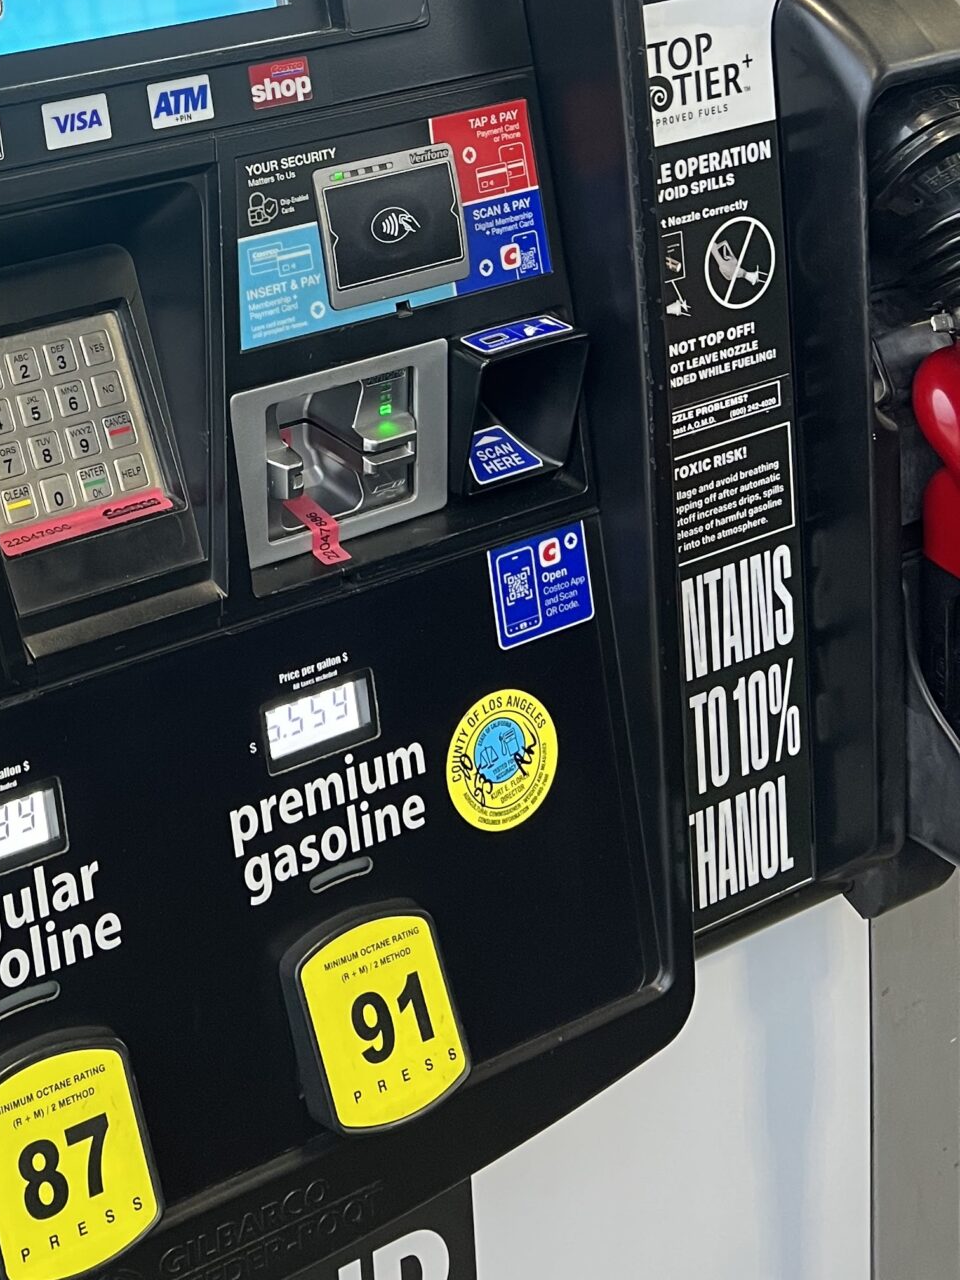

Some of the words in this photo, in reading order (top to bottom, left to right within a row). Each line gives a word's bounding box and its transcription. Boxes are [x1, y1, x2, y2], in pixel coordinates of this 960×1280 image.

[647, 33, 712, 73] TOP
[153, 84, 208, 119] ATM
[251, 73, 312, 104] shop
[51, 109, 102, 133] VISA
[469, 115, 489, 129] TAP
[499, 110, 518, 122] PAY
[699, 104, 728, 118] FUELS
[245, 156, 279, 176] YOUR
[280, 147, 336, 169] SECURITY
[409, 147, 449, 165] Verifone
[677, 139, 771, 181] OPERATION
[691, 173, 735, 195] SPILLS
[668, 212, 701, 228] Nozzle
[702, 198, 748, 219] Correctly
[669, 337, 697, 357] NOT
[698, 330, 724, 349] TOP
[726, 322, 755, 341] OFF!
[686, 351, 719, 370] LEAVE
[720, 340, 758, 360] NOZZLE
[476, 443, 514, 462] SCAN
[484, 455, 525, 475] HERE
[80, 466, 104, 480] ENTER
[4, 487, 29, 501] CLEAR
[542, 567, 567, 584] Open
[543, 580, 569, 595] Costco
[571, 574, 585, 589] App
[544, 594, 558, 607] and
[560, 588, 578, 602] Scan
[546, 605, 557, 617] QR
[558, 598, 579, 613] Code.
[681, 545, 794, 681] NTAINS
[689, 686, 730, 795] TO
[733, 658, 801, 777] 10%
[229, 742, 426, 858] premium
[244, 794, 426, 906] gasoline
[689, 775, 794, 909] HANOL
[351, 971, 435, 1064] 91
[36, 1078, 72, 1099] OCTANE
[74, 1064, 106, 1084] RATING
[58, 1087, 95, 1108] METHOD
[18, 1112, 109, 1220] 87
